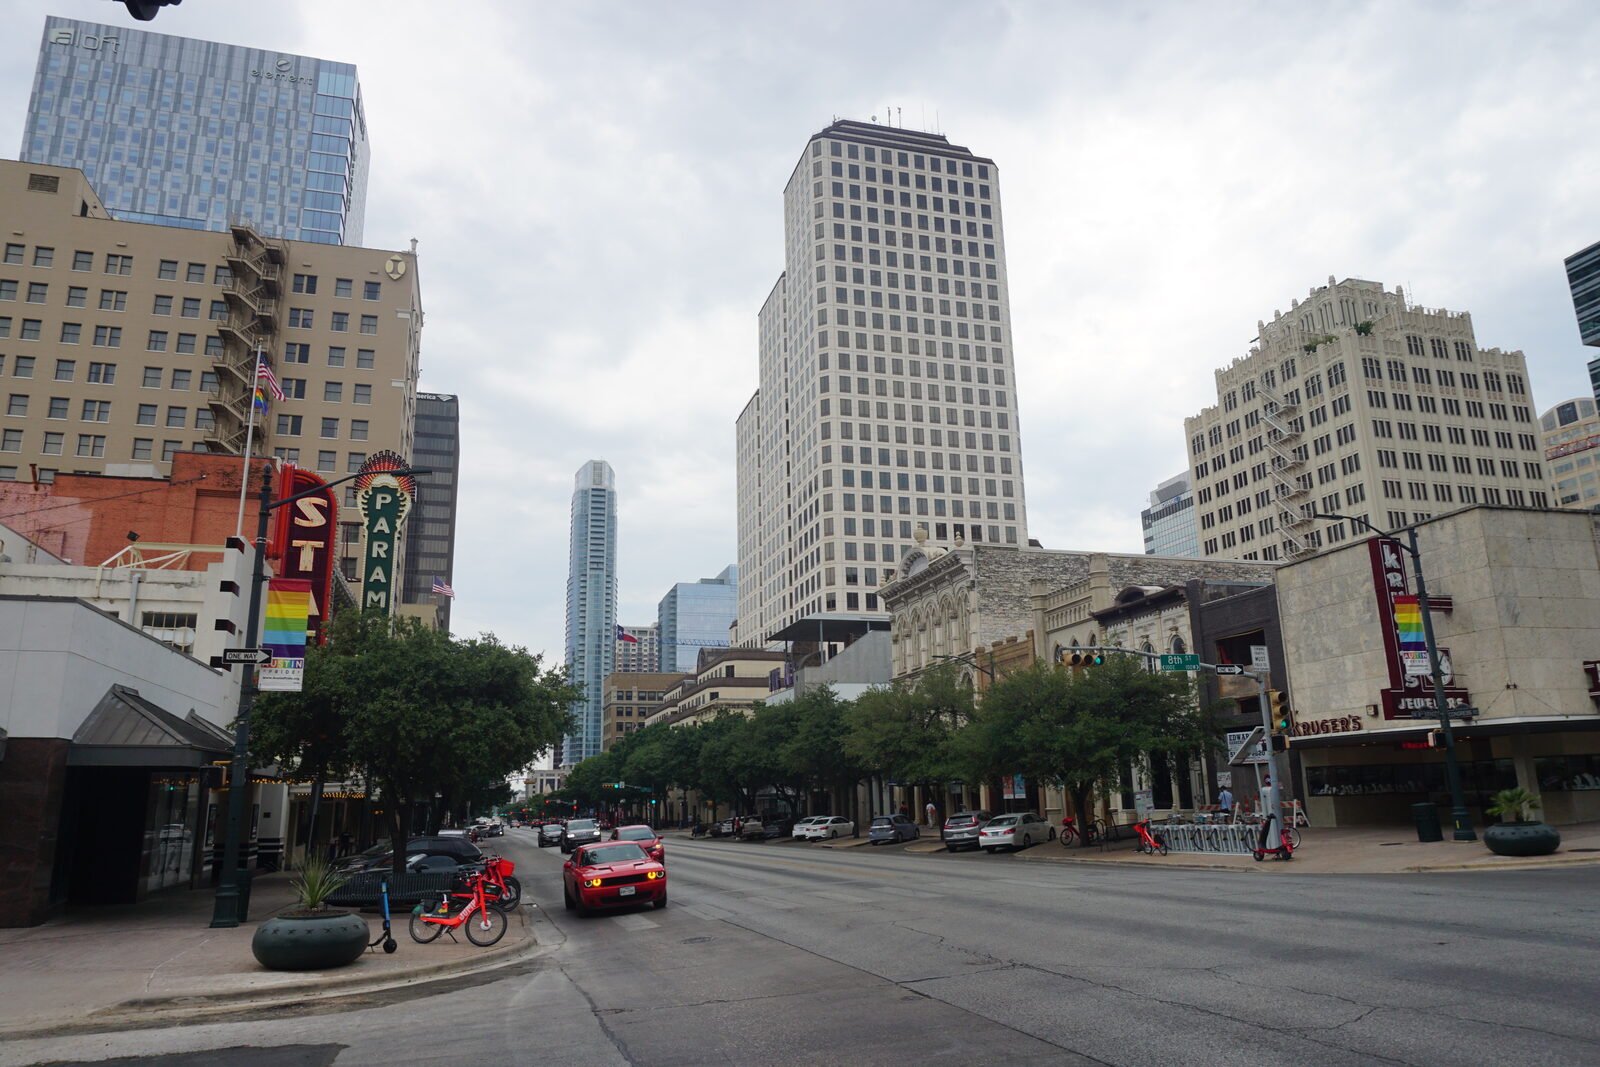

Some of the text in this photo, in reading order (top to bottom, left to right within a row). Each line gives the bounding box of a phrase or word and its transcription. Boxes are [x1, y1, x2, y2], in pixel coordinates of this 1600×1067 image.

[50, 27, 120, 54] aloft
[251, 68, 313, 86] element
[227, 652, 257, 660] ONE WAY
[1167, 655, 1183, 665] 8th
[1403, 652, 1428, 660] AUSTIN
[1398, 697, 1464, 710] JEWELRS
[1289, 714, 1362, 737] KRUGER'S
[1228, 733, 1252, 741] EDWAR
[459, 898, 478, 921] JUMP
